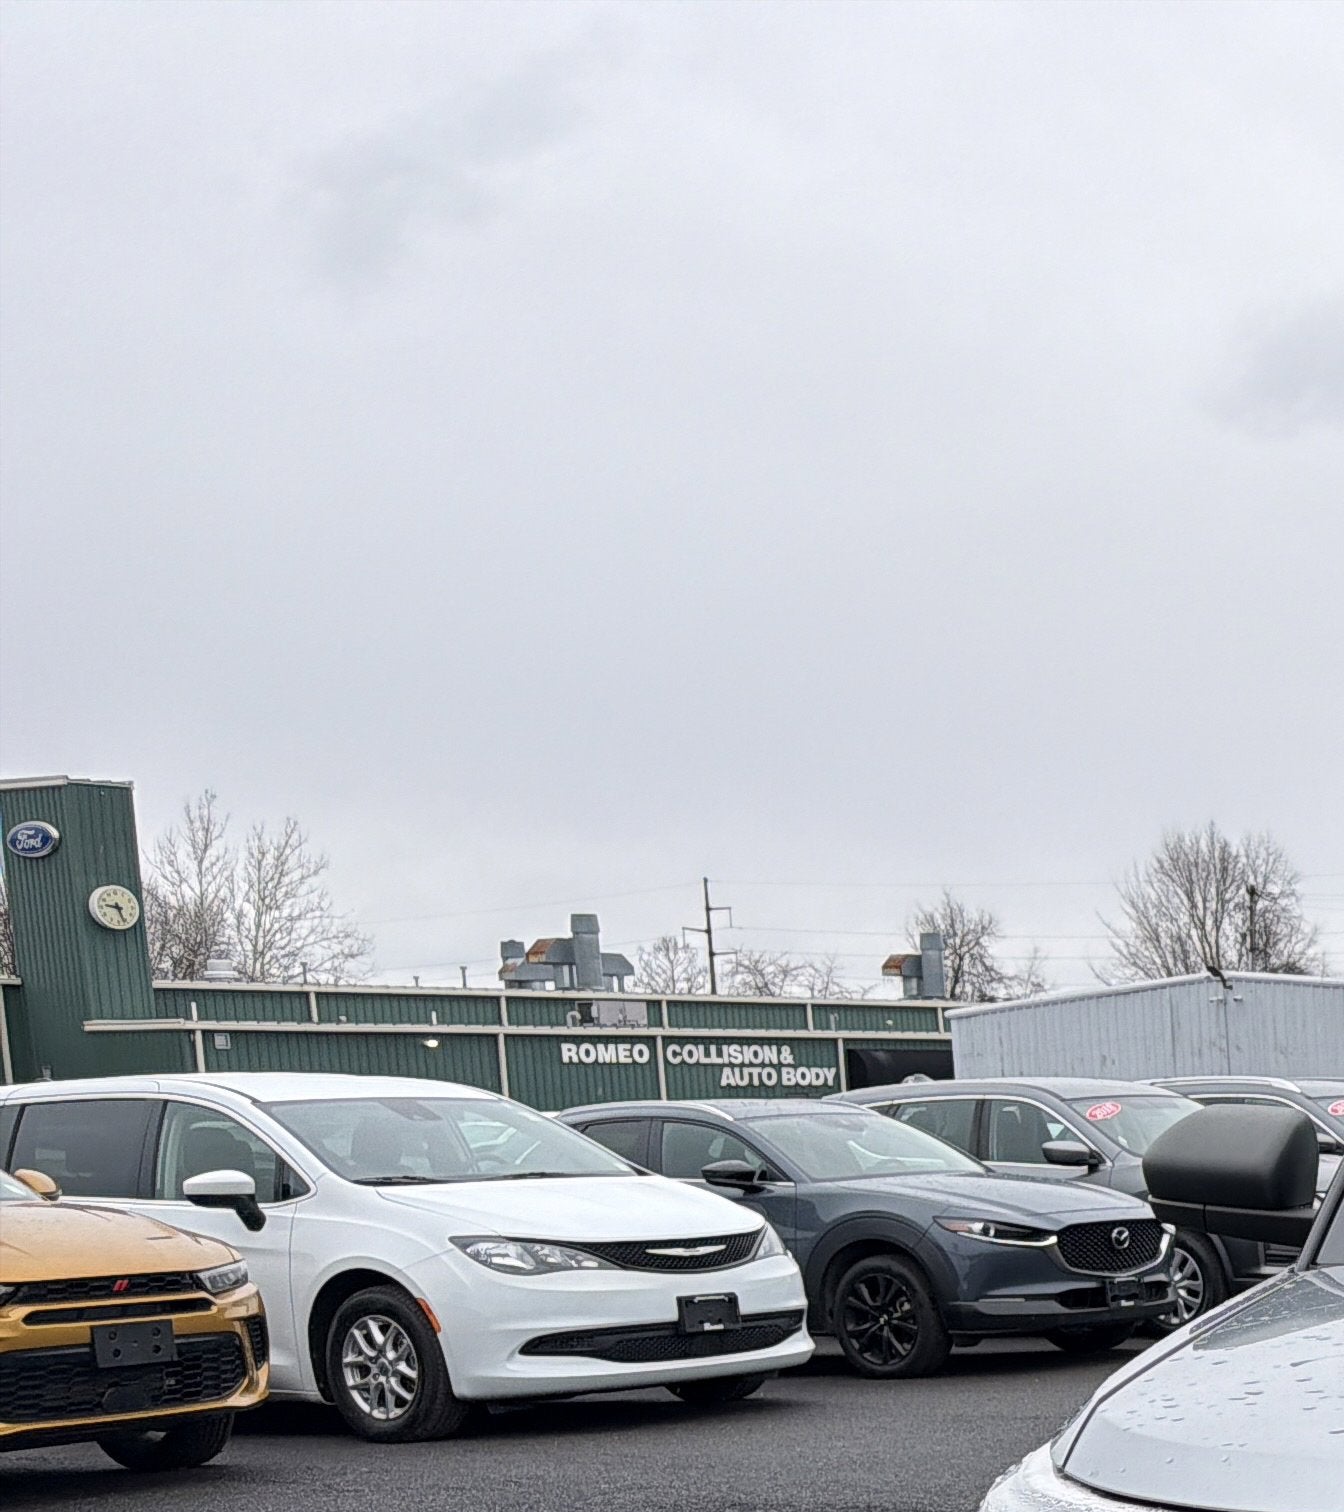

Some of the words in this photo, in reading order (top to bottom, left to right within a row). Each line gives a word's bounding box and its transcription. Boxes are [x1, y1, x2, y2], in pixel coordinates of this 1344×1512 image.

[15, 829, 43, 850] Ford
[560, 1042, 650, 1064] ROMEO
[720, 1066, 778, 1087] AUTO
[781, 1066, 837, 1087] BODY
